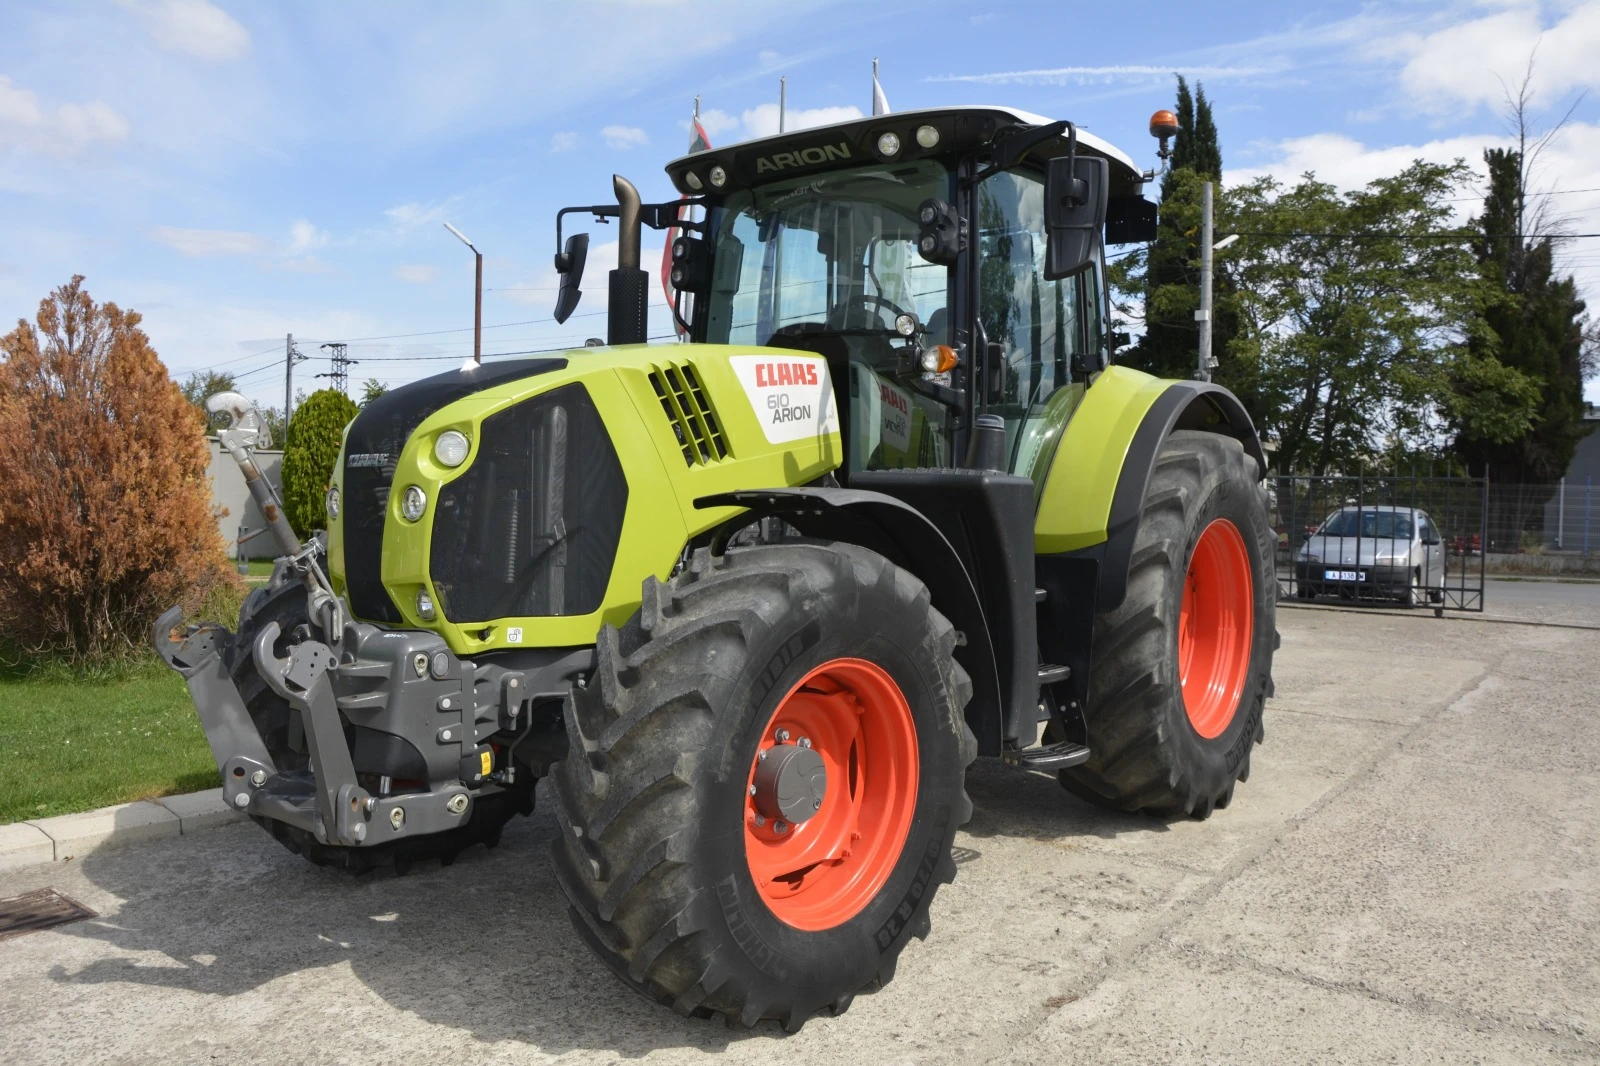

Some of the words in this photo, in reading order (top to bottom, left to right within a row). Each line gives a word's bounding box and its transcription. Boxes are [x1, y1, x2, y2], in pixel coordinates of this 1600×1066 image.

[756, 142, 852, 174] ARION
[755, 363, 818, 387] CLAAS
[767, 393, 790, 409] 610
[772, 404, 811, 424] ARION
[898, 902, 913, 921] R
